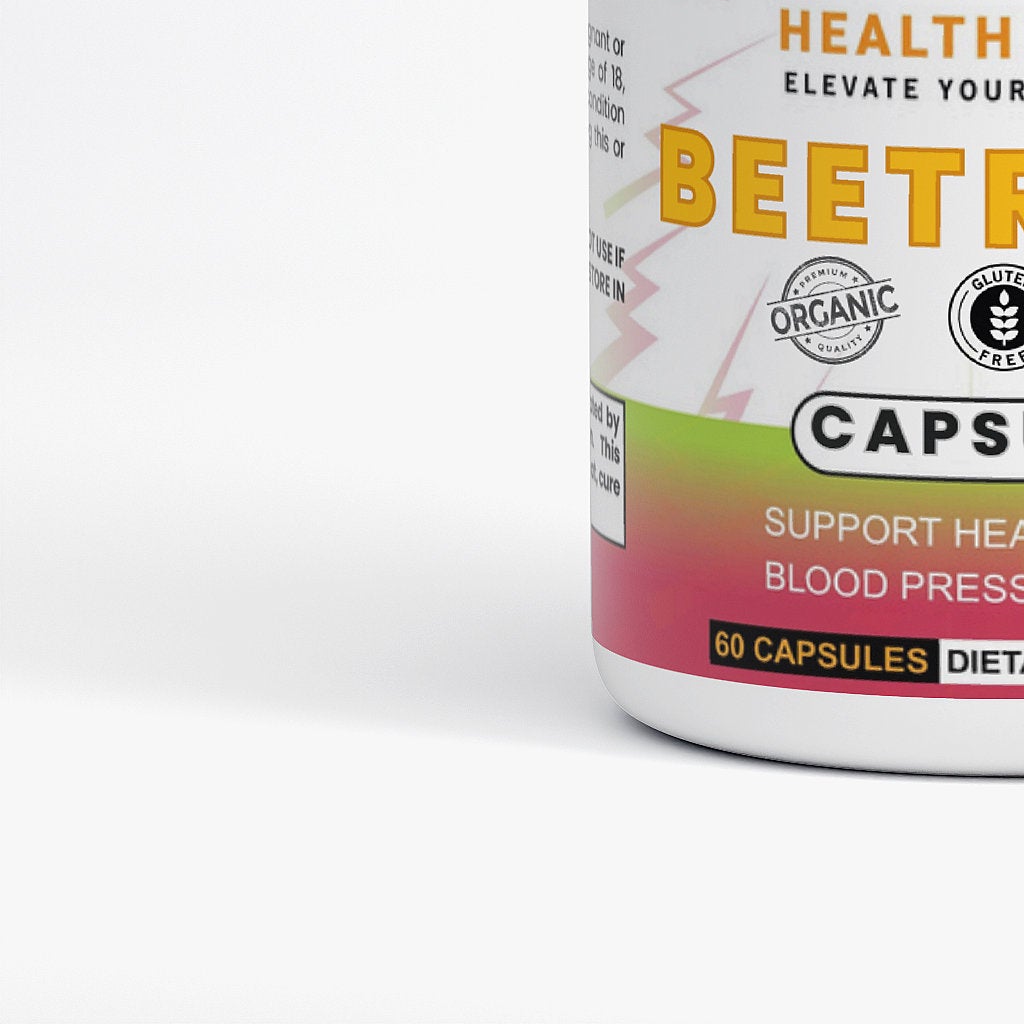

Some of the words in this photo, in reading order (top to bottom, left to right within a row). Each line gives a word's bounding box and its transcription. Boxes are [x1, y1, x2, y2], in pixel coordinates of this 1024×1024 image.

[612, 36, 625, 57] or
[780, 7, 1010, 59] HEALTH
[597, 60, 608, 84] of
[611, 63, 625, 95] 18,
[784, 72, 919, 99] ELEVATE
[613, 139, 625, 159] or
[596, 235, 613, 265] USE
[615, 245, 625, 269] IF
[612, 277, 625, 304] IN
[799, 268, 848, 288] PREMIUM
[770, 284, 899, 335] ORGANIC
[817, 334, 863, 353] QUALITY
[606, 405, 620, 439] by
[600, 434, 620, 465] This
[598, 469, 620, 497] cure
[764, 507, 942, 547] SUPPORT
[764, 561, 888, 600] BLOOD
[714, 631, 744, 661] 60
[753, 636, 929, 675] CAPSULES
